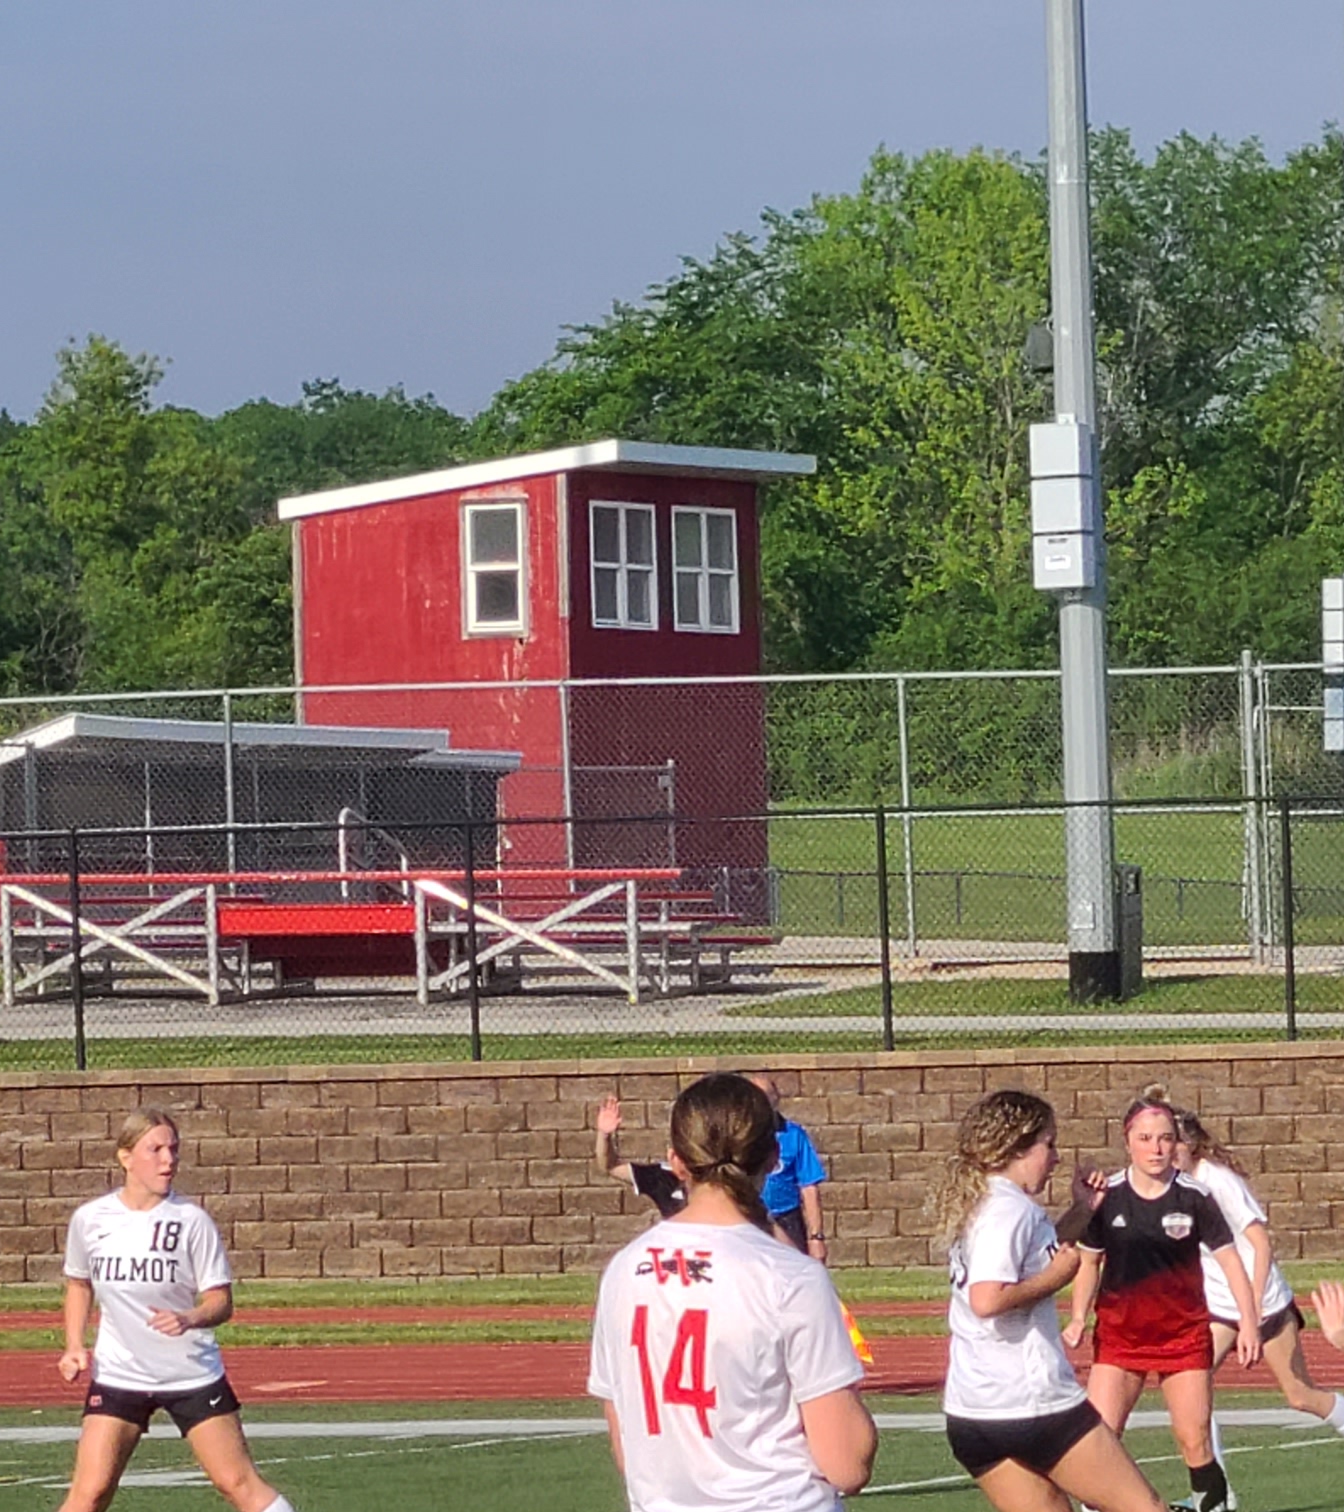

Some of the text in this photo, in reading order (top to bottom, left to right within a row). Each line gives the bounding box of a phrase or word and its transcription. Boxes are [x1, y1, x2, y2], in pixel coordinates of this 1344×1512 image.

[149, 1220, 182, 1252] 18
[90, 1257, 178, 1283] WILMOT
[630, 1304, 716, 1439] 14
